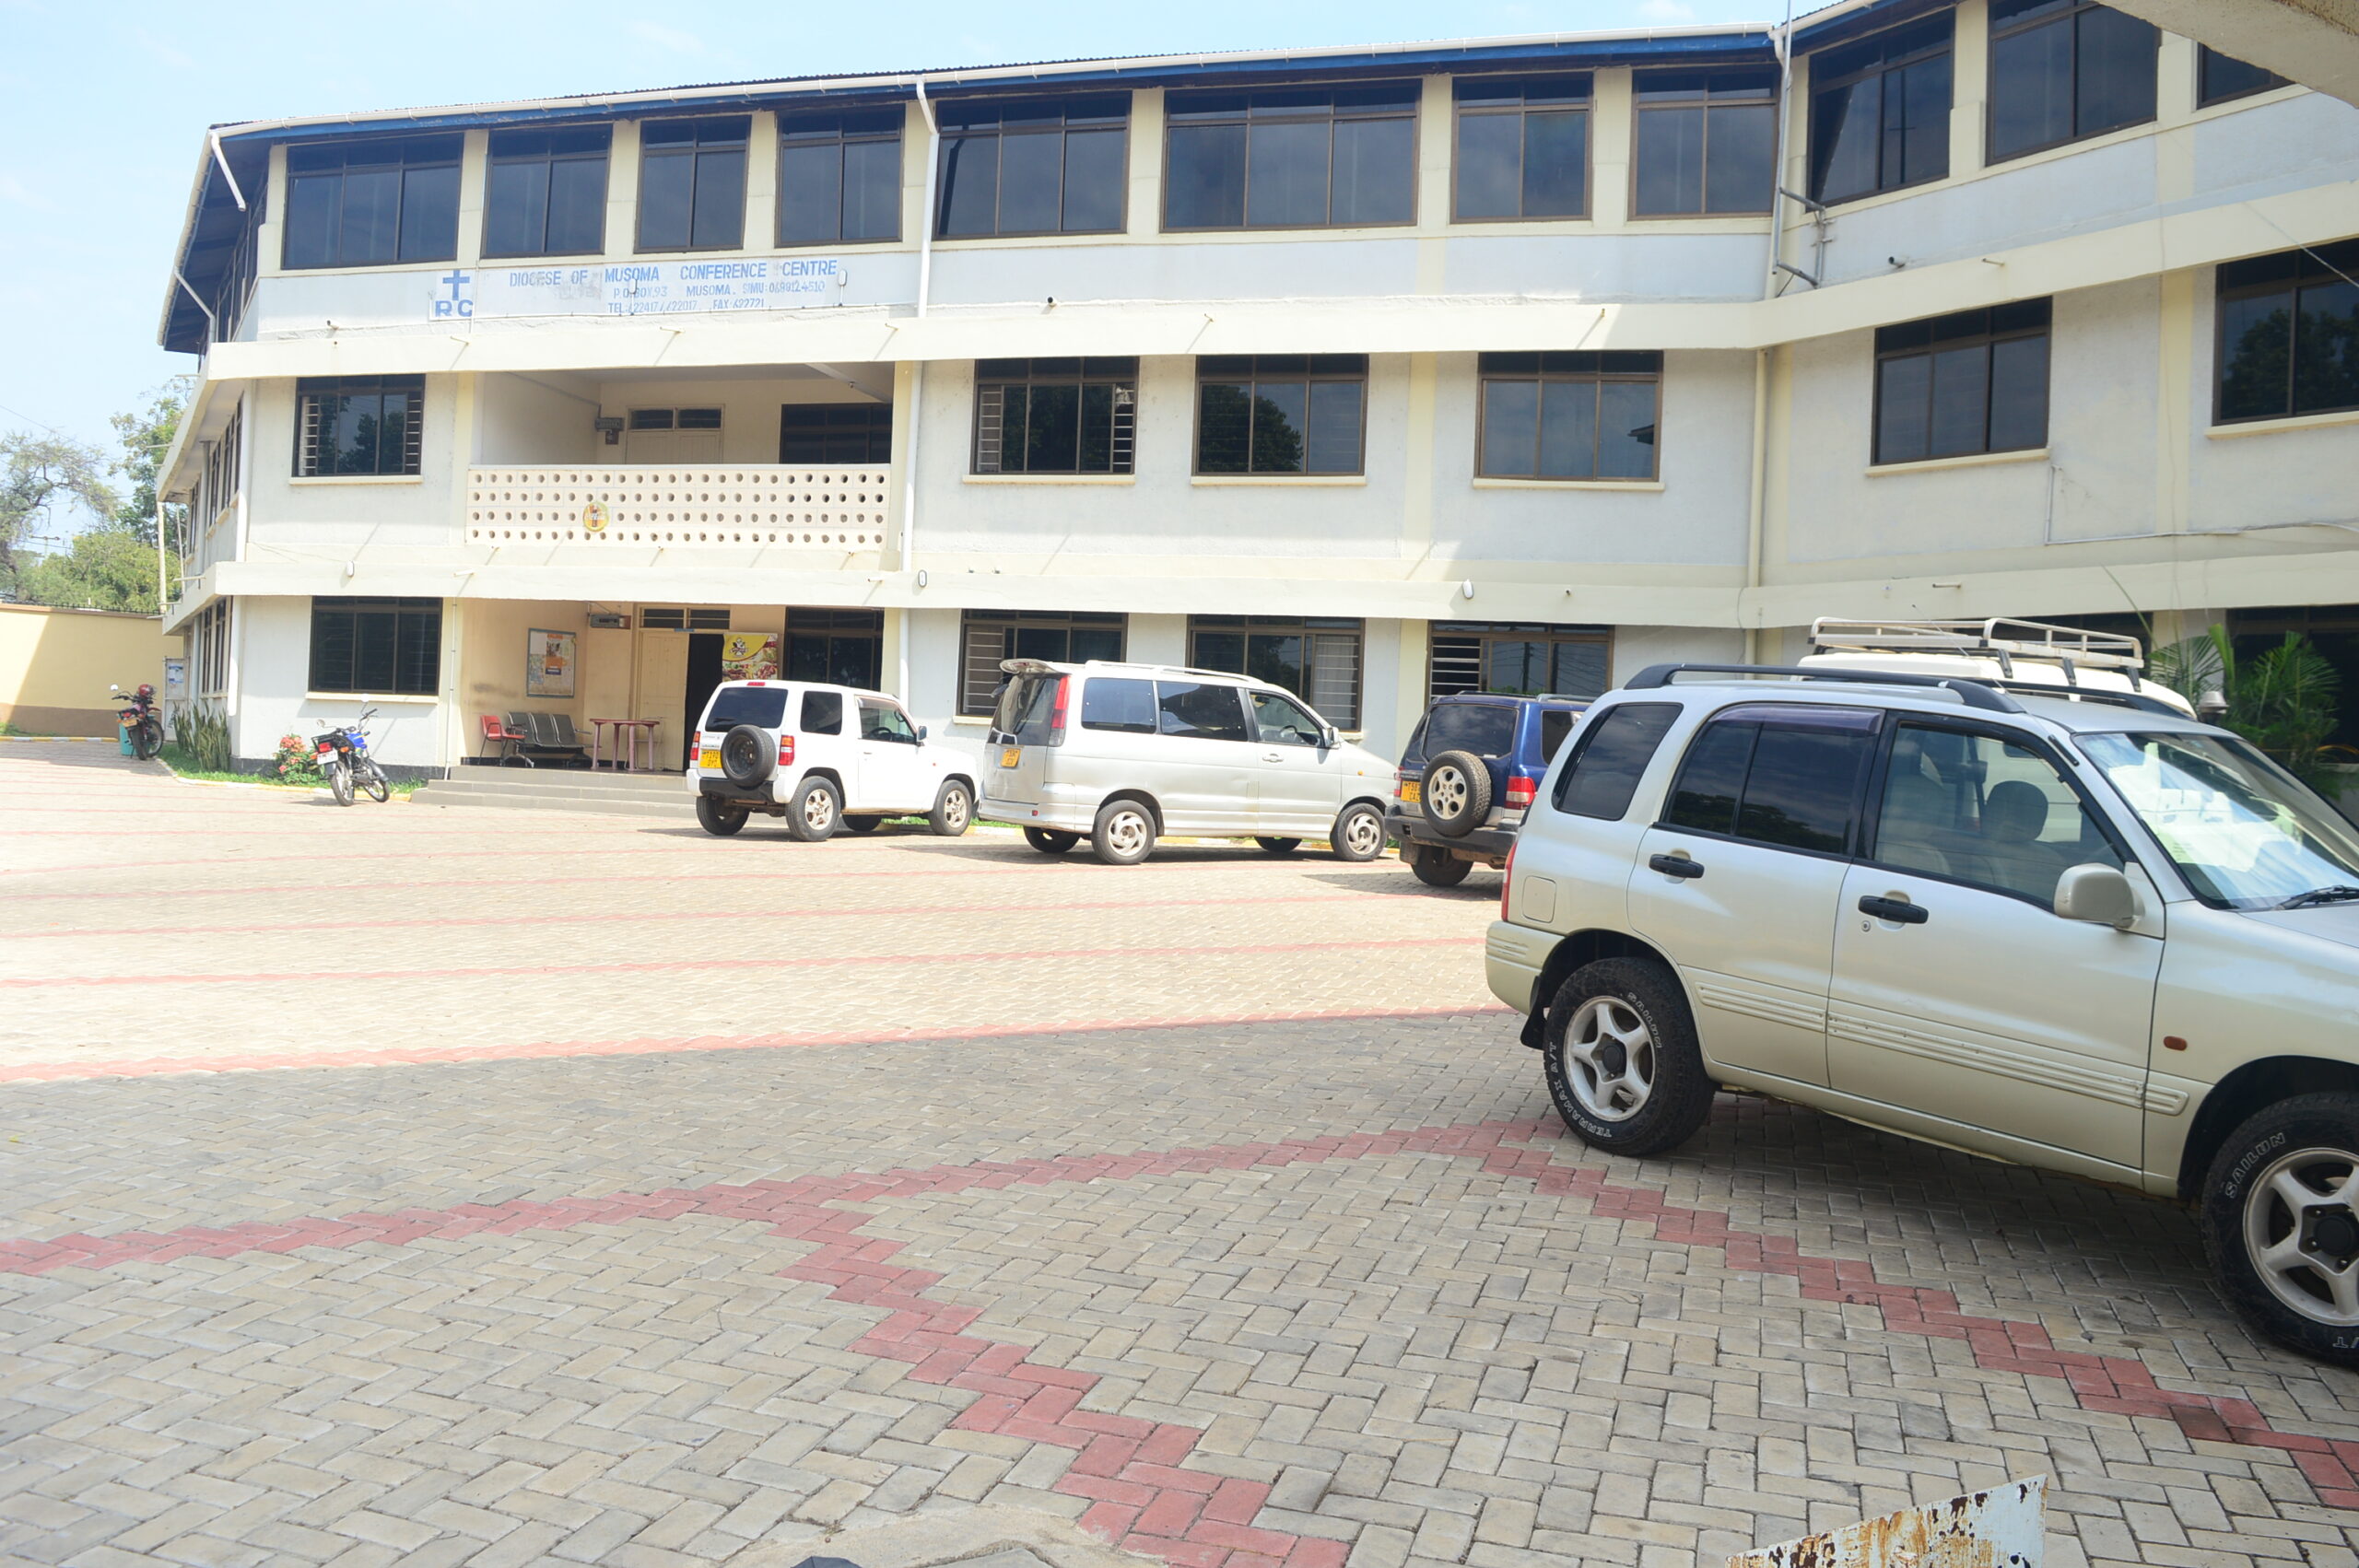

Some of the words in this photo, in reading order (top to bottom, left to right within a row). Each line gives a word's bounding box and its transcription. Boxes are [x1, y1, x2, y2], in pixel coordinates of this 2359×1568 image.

[510, 271, 561, 287] DIOCESE
[571, 270, 588, 285] OF
[604, 266, 660, 282] MUSOMA
[680, 263, 767, 280] CONFERENCE
[782, 260, 838, 276] CENTRE
[2224, 1132, 2286, 1199] SAILUN
